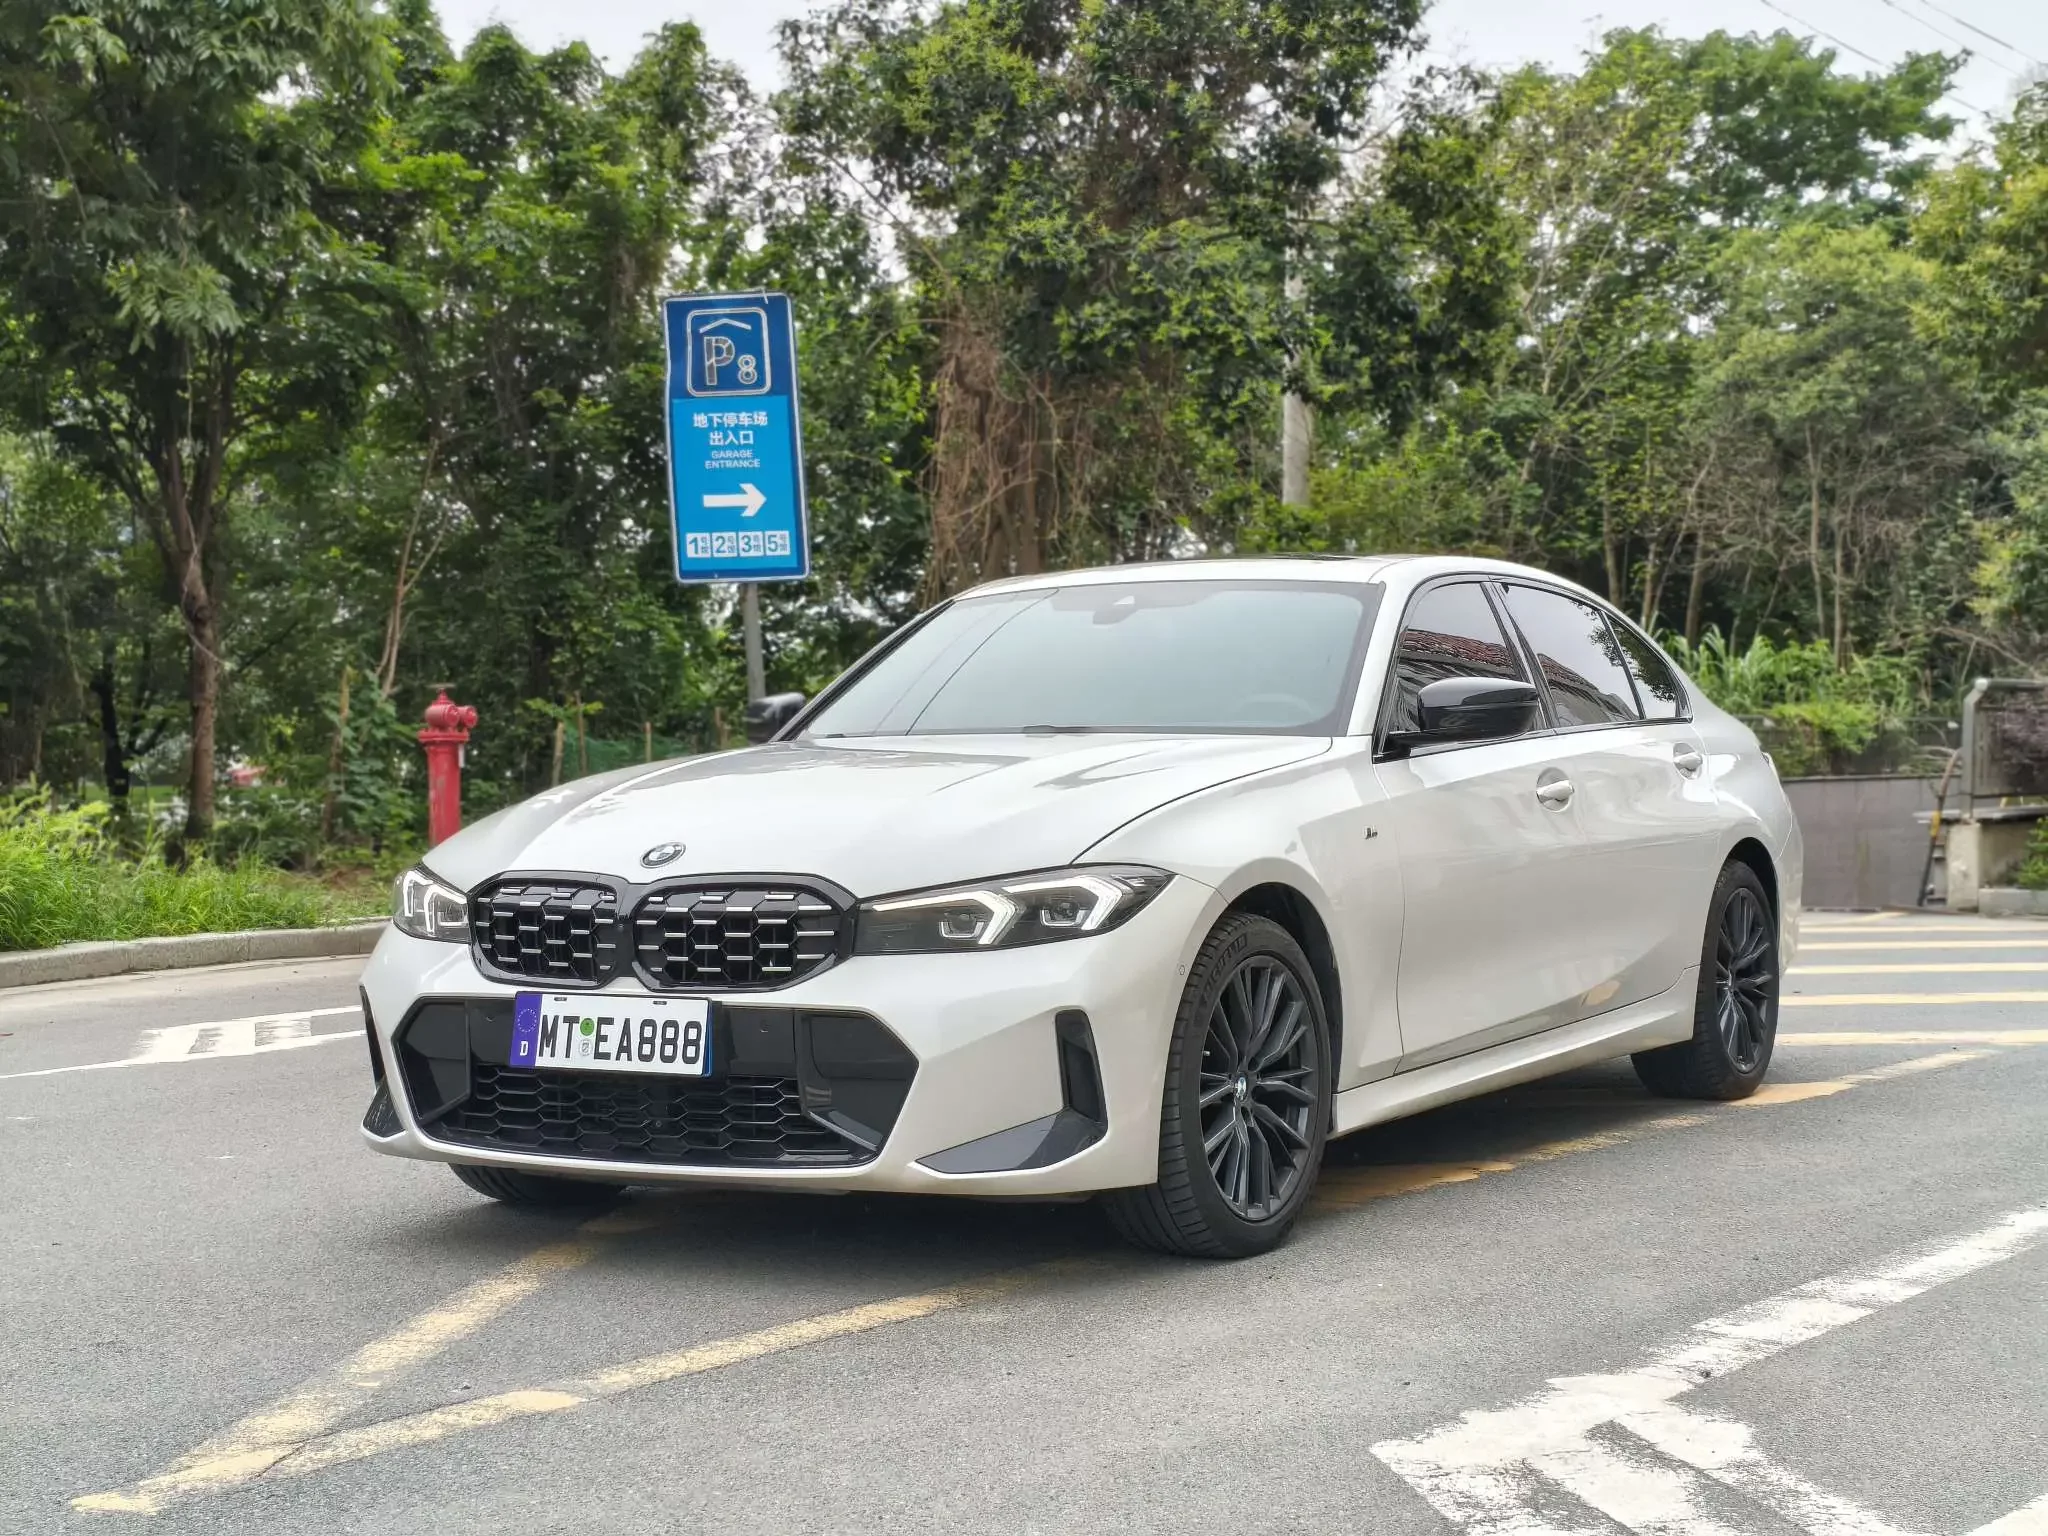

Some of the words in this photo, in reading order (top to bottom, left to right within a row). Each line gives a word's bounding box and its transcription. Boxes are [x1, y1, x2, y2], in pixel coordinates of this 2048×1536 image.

[693, 411, 768, 428] 地下停车场
[709, 430, 754, 446] 出入口
[711, 449, 753, 459] GARAGE
[704, 459, 761, 470] ENTRANCE
[538, 1014, 580, 1058] MT
[593, 1017, 703, 1065] EA888
[518, 1040, 529, 1056] D
